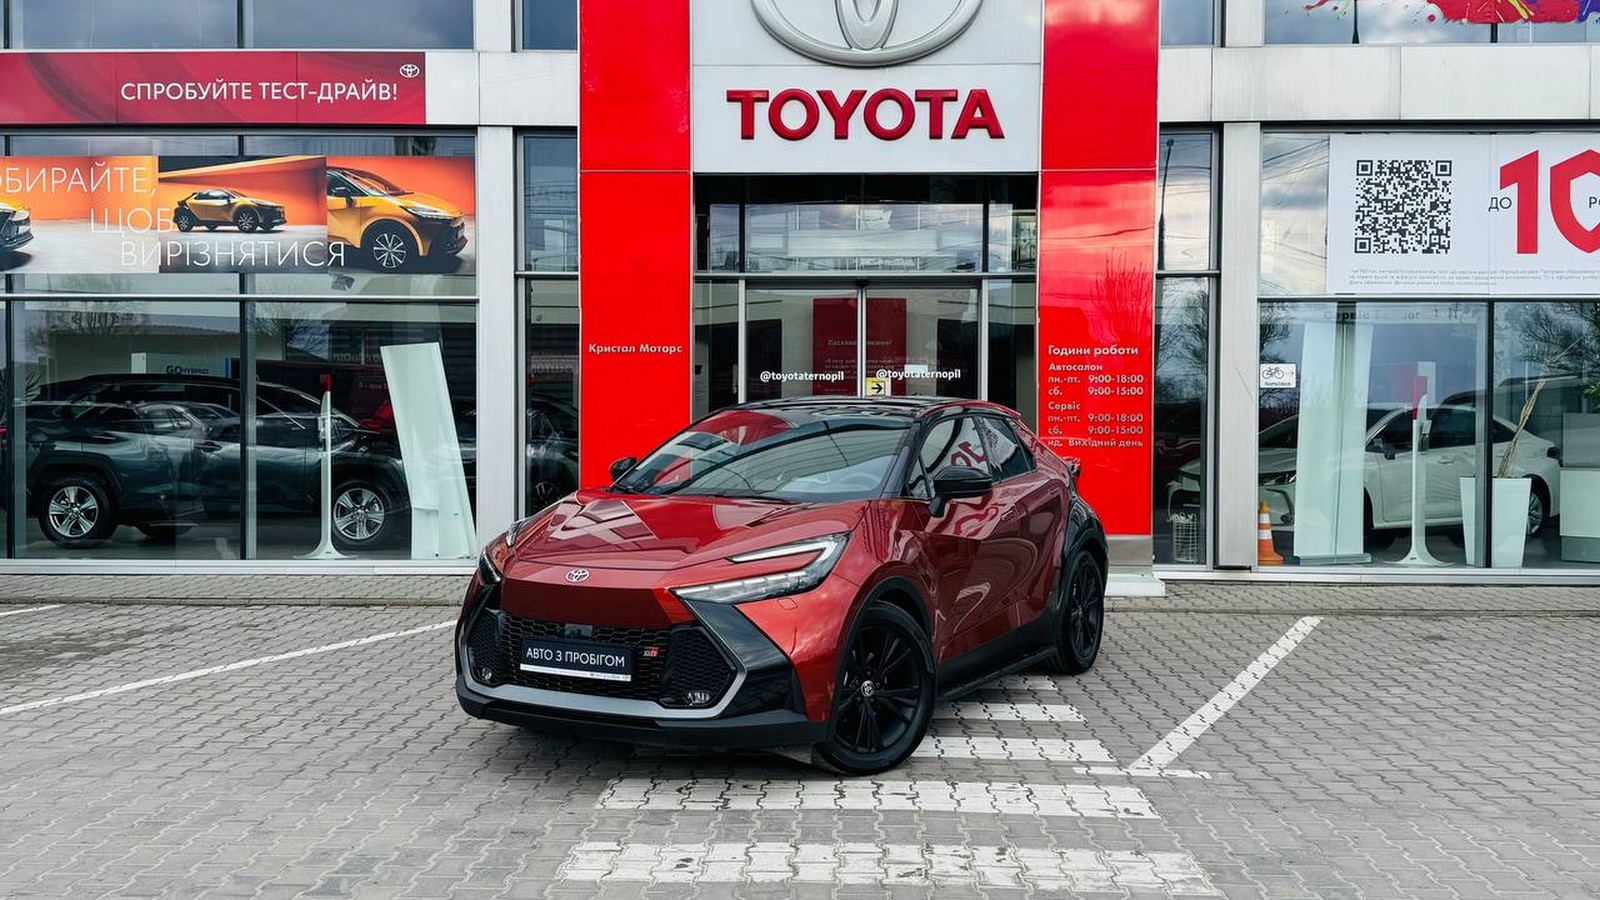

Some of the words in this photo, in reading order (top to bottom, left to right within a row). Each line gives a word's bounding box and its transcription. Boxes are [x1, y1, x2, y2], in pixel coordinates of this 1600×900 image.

[120, 78, 252, 101] СПРОБУЙТЕ
[258, 79, 398, 103] ТЕСТ-ДРАЙВ!
[726, 88, 1005, 141] TOYOTA
[0, 161, 156, 197] БИРАЙТЕ,
[1488, 196, 1512, 212] ДО
[90, 207, 173, 237] ЩОБ
[120, 240, 346, 267] ВИРІЗНЯТИСЯ
[588, 343, 636, 354] Кристал
[639, 343, 682, 354] Моторс
[1048, 344, 1091, 356] Години
[1094, 344, 1139, 357] роботи
[1048, 363, 1103, 371] Автосалон
[760, 371, 844, 383] @toyotaternopil
[876, 368, 961, 380] @toyotaternopil
[1088, 374, 1144, 383] 9:00-18:00
[1048, 386, 1062, 395] сб.
[1088, 386, 1144, 395] 9:00-15:00
[1048, 401, 1081, 412] Сервіс
[1088, 413, 1144, 422] 9:00-18:00
[1048, 425, 1062, 435] сб.
[1087, 425, 1144, 435] 9:00-15:00
[1068, 437, 1117, 447] Вихідний
[526, 647, 553, 660] АВТО
[555, 650, 562, 661] З
[565, 651, 625, 667] ПРОБІГОМ
